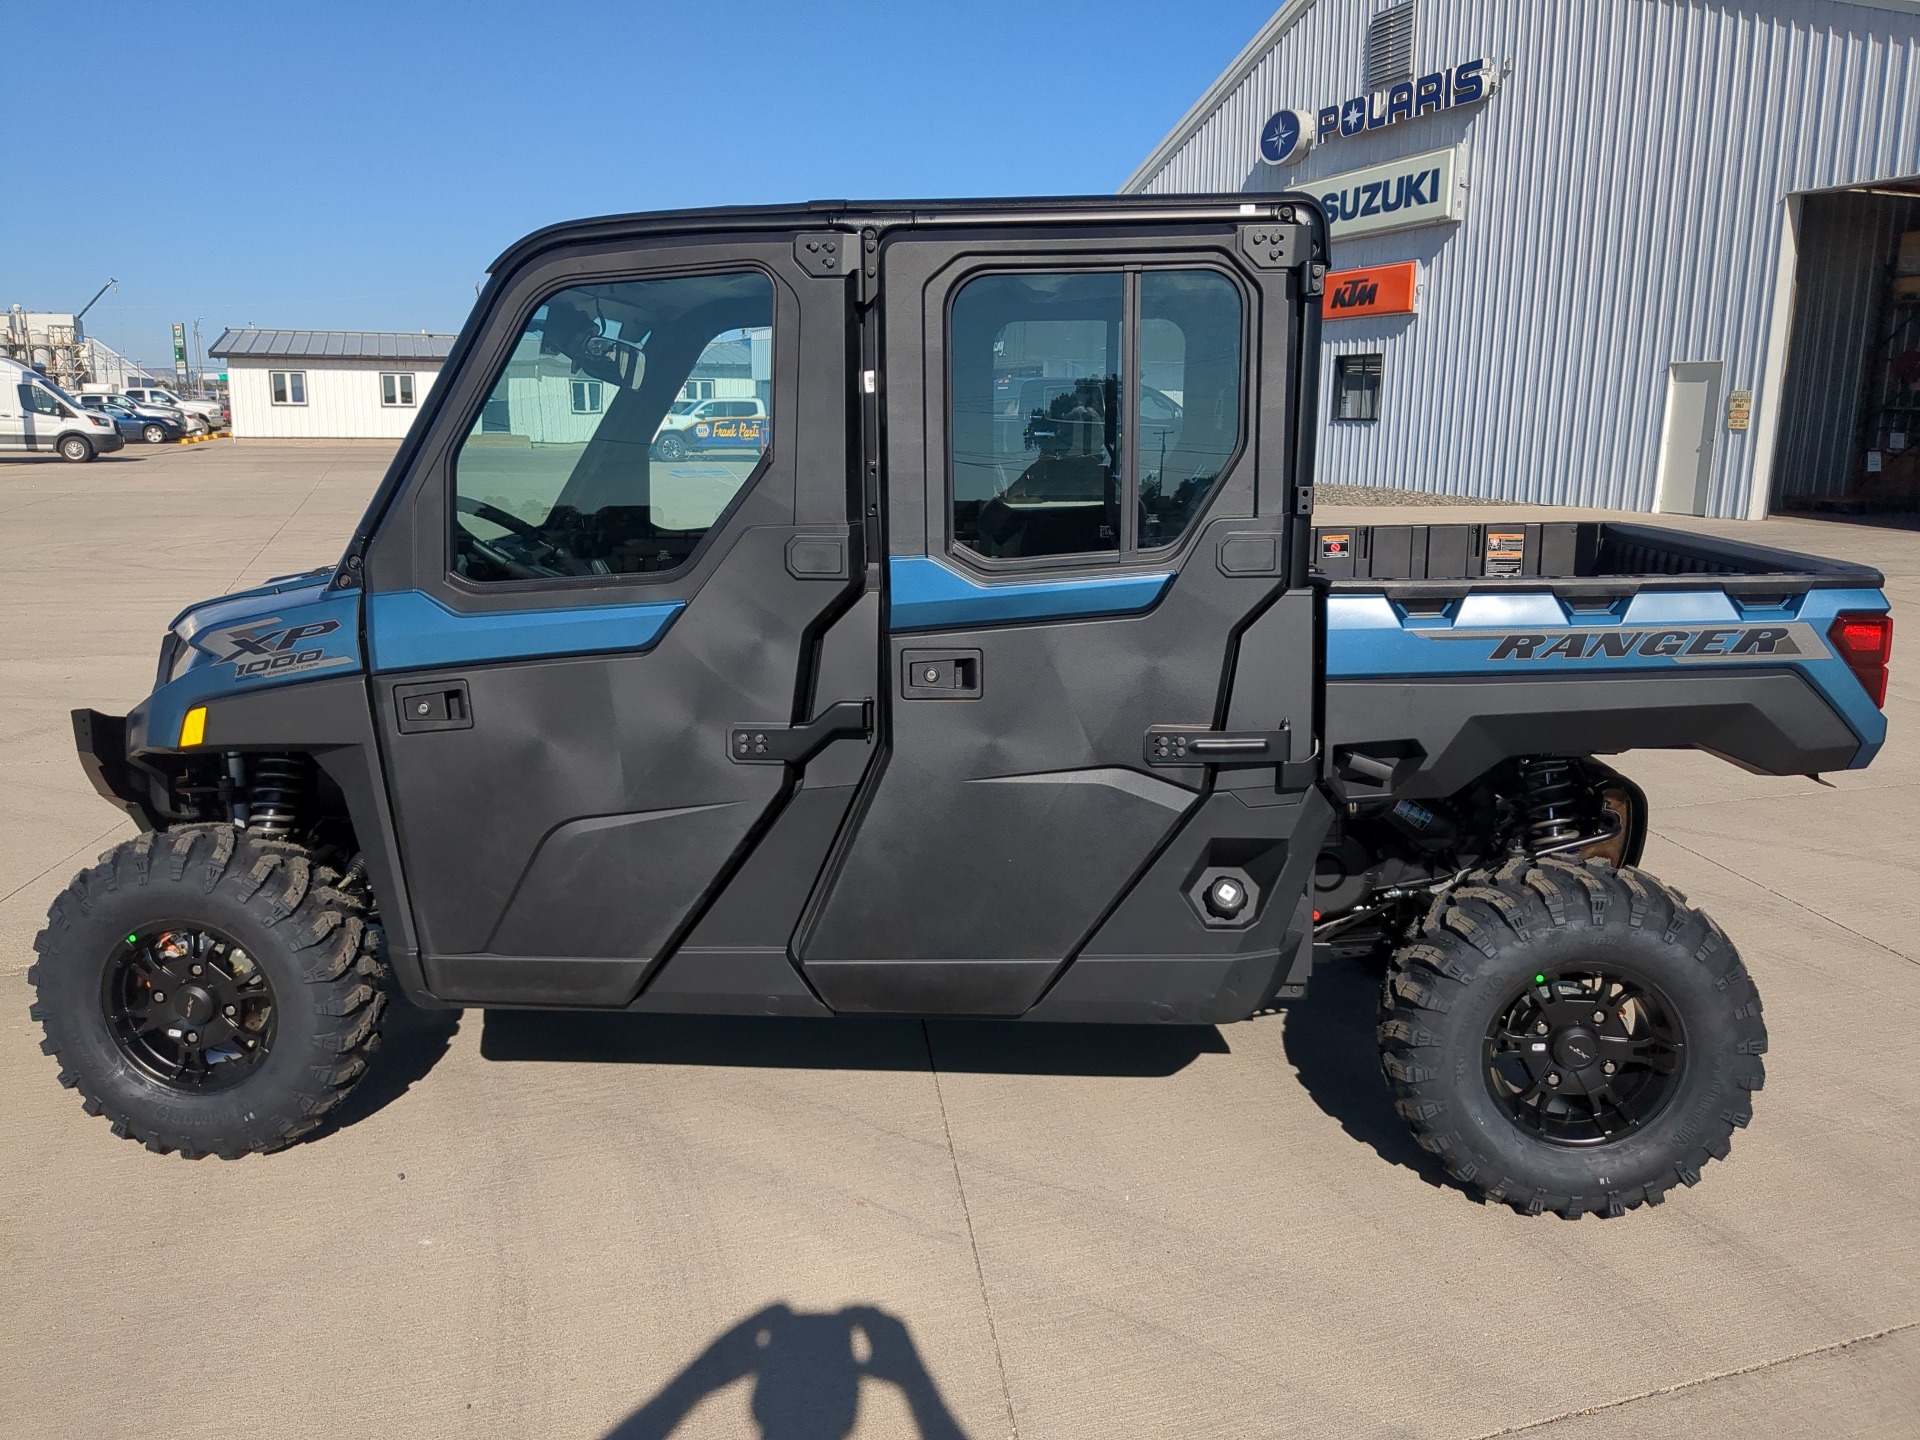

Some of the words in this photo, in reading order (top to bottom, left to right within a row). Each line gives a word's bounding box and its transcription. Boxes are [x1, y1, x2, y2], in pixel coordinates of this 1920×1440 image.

[1317, 58, 1487, 144] POLARIS
[1321, 168, 1440, 225] SUZUKI
[1330, 278, 1379, 310] KTM
[712, 421, 737, 438] Frank
[739, 421, 760, 438] Parts
[211, 619, 341, 666] XP
[1487, 627, 1790, 661] RANGER
[235, 648, 324, 677] 1000
